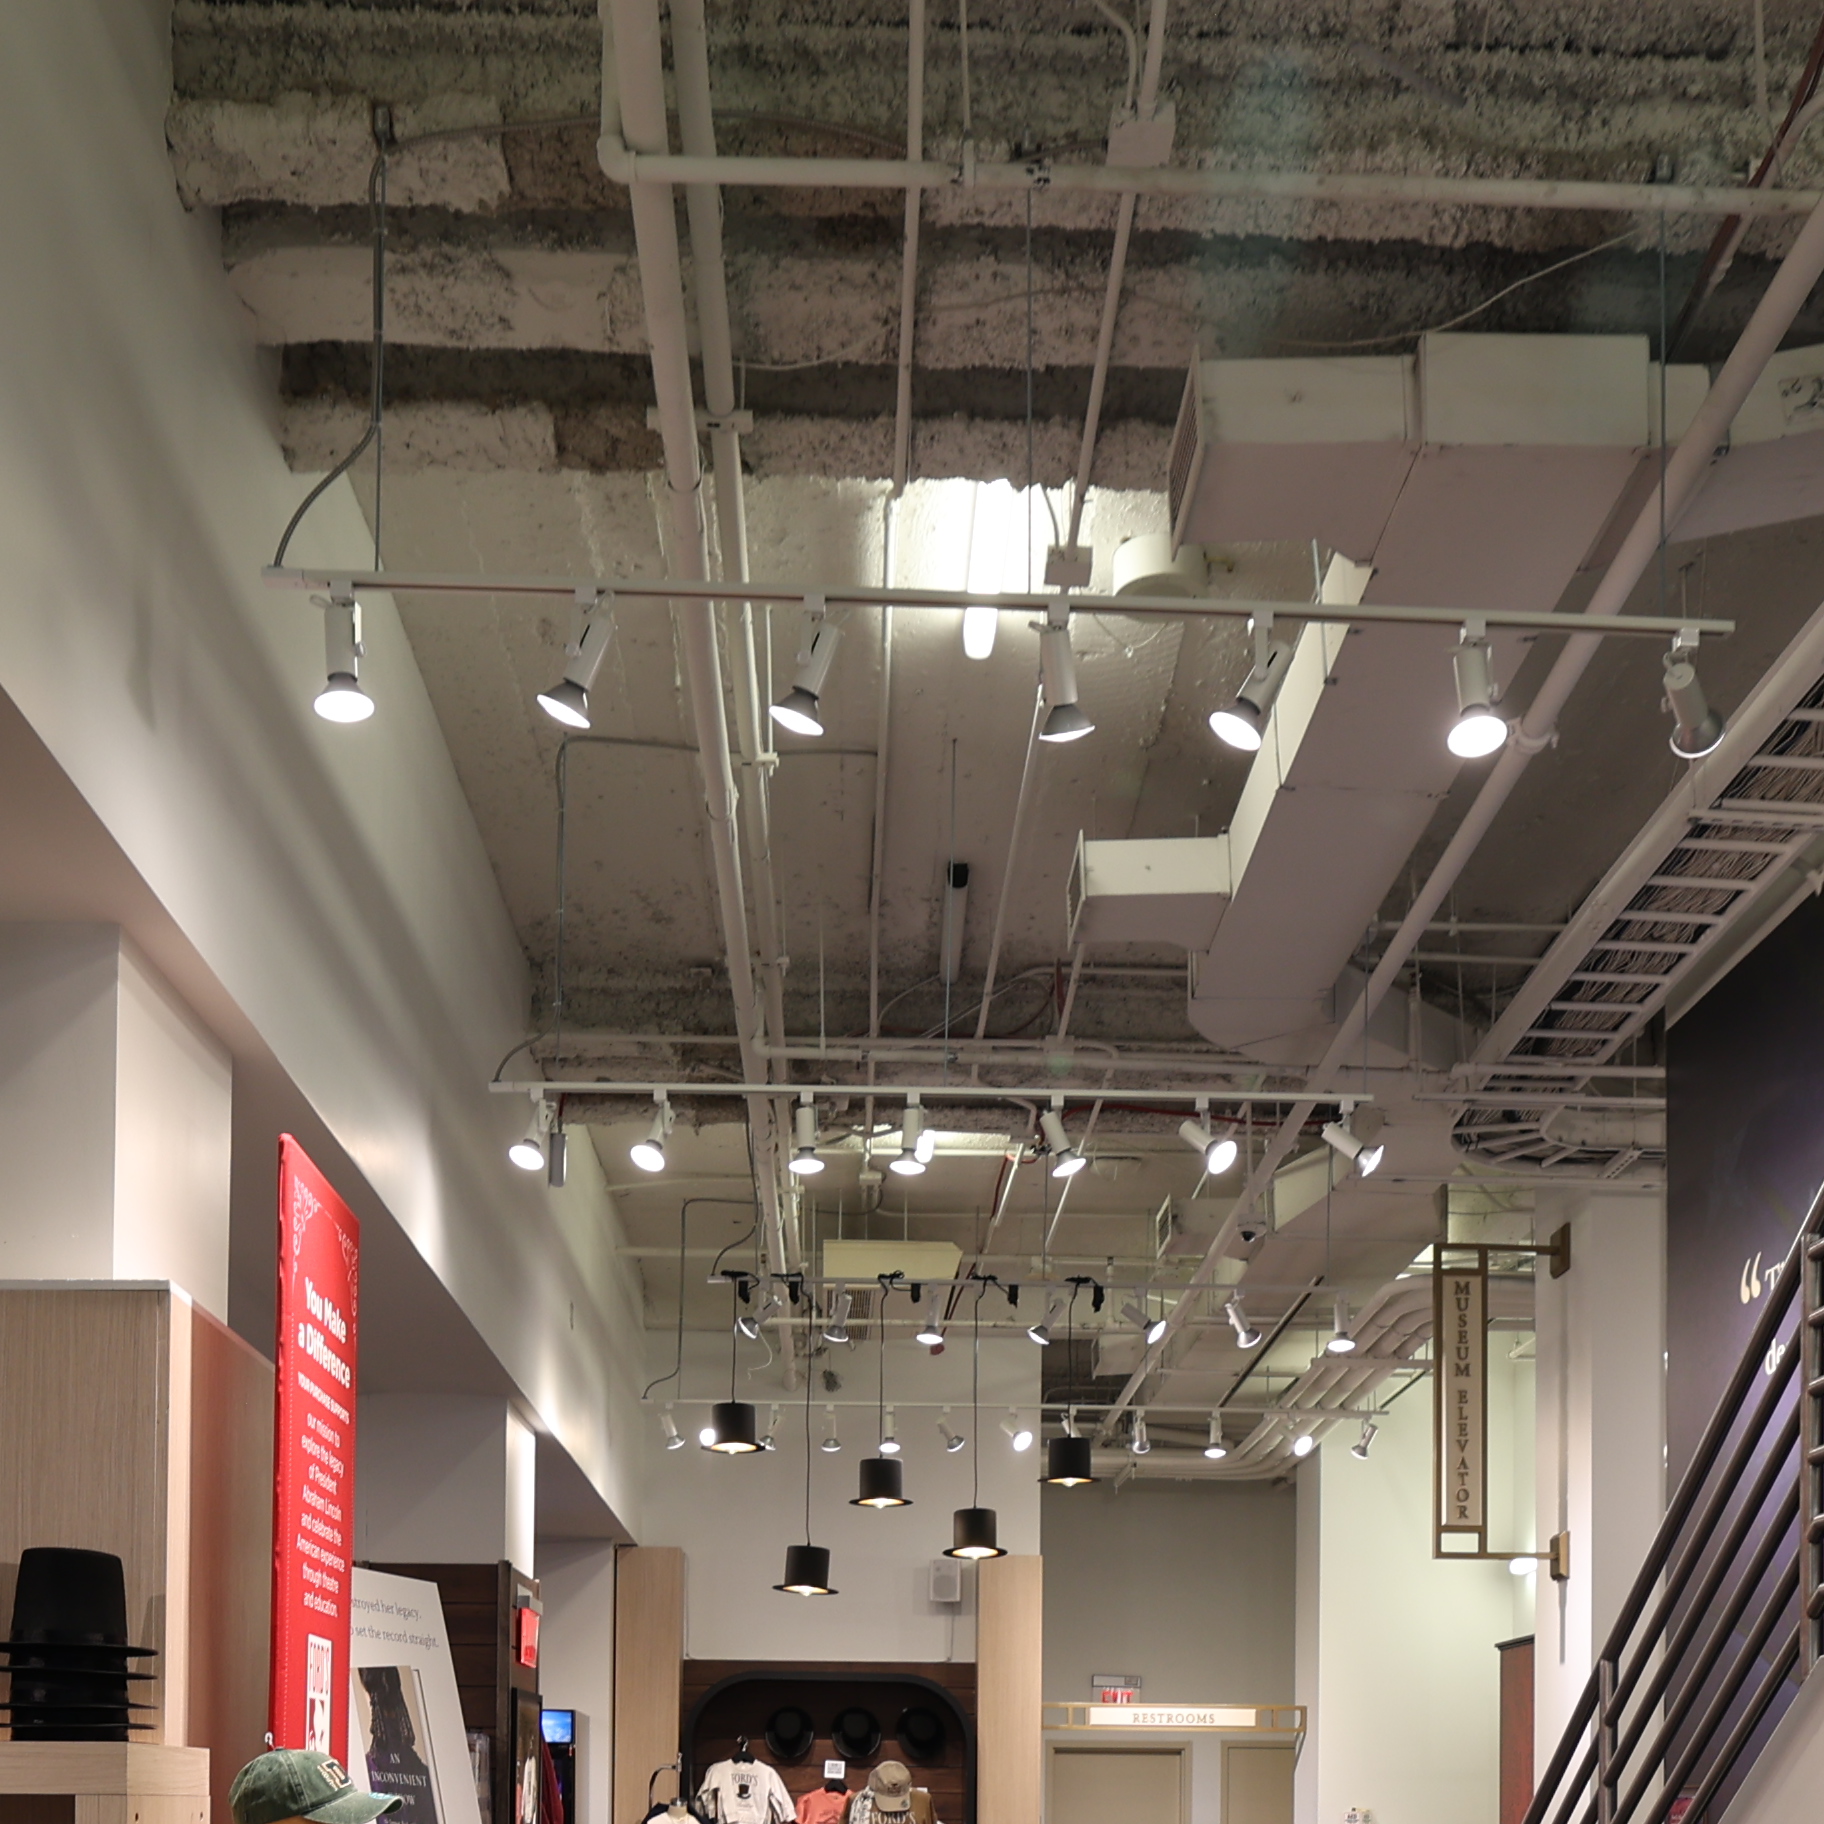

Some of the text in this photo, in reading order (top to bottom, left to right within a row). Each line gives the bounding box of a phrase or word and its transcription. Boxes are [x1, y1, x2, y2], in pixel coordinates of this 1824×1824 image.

[304, 1276, 347, 1344] You Make
[298, 1322, 351, 1389] a Difference
[1454, 1280, 1471, 1520] MUSEUM ELEVATOR
[307, 1412, 316, 1429] our
[334, 1431, 341, 1449] to
[301, 1434, 321, 1461] explore
[321, 1444, 329, 1466] the
[308, 1463, 338, 1496] of President
[302, 1484, 342, 1523] Abraham Lincoln
[301, 1513, 342, 1547] and celebrate the
[296, 1533, 345, 1573] American experience
[302, 1562, 322, 1589] through
[303, 1591, 314, 1609] and
[352, 1598, 422, 1622] stroyed her legacy.
[355, 1625, 439, 1650] set the record straight.
[1101, 1690, 1134, 1703] EXIT
[1133, 1712, 1216, 1724] RESTROOMS
[390, 1753, 400, 1764] AN
[371, 1770, 427, 1787] INCONVENIENT
